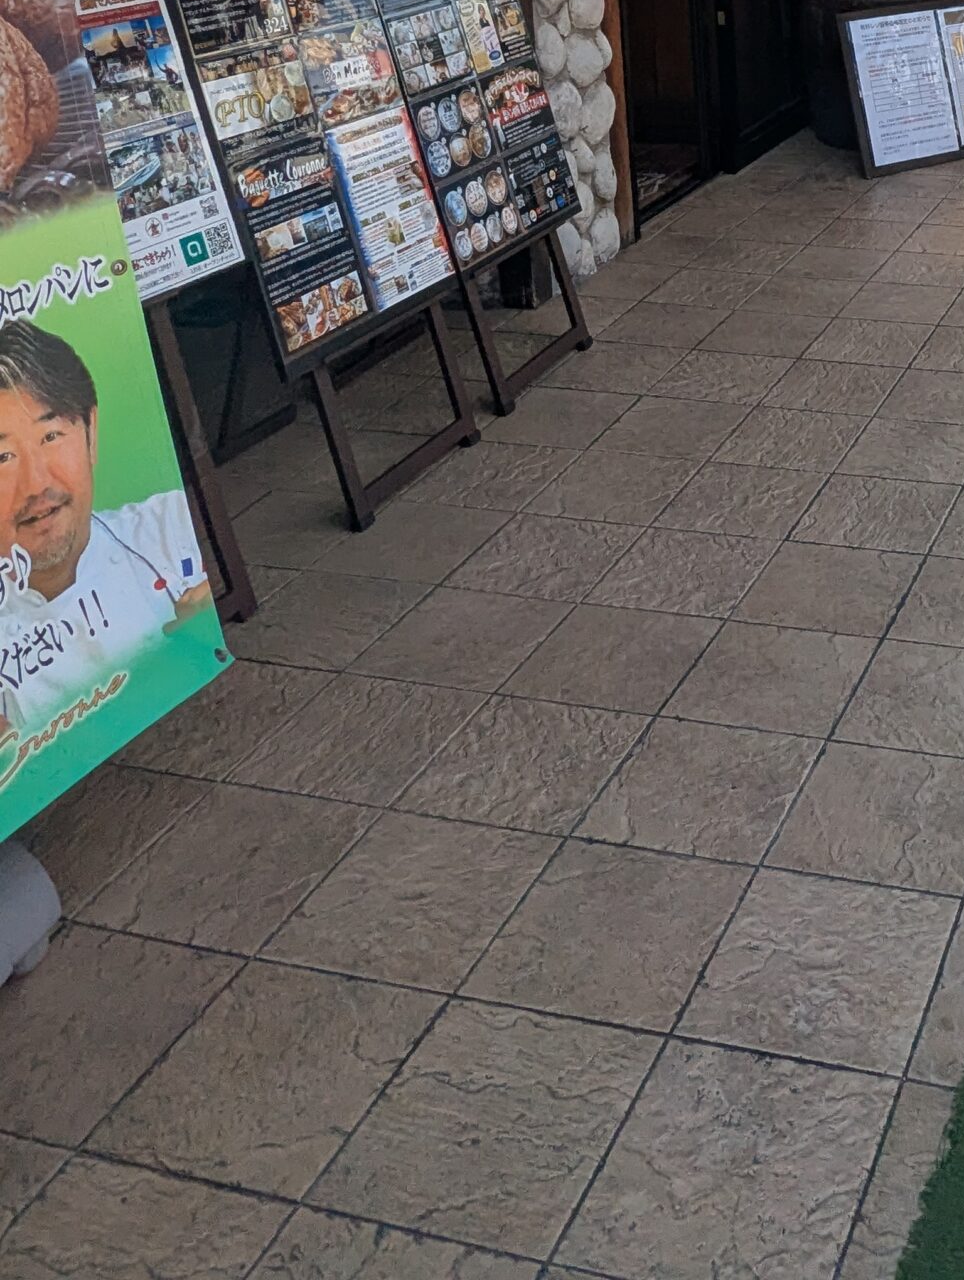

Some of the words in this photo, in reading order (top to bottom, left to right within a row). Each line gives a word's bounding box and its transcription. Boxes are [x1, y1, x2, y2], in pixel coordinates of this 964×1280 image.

[263, 16, 289, 34] 324
[237, 169, 285, 198] Baguette
[286, 158, 326, 180] Couronne
